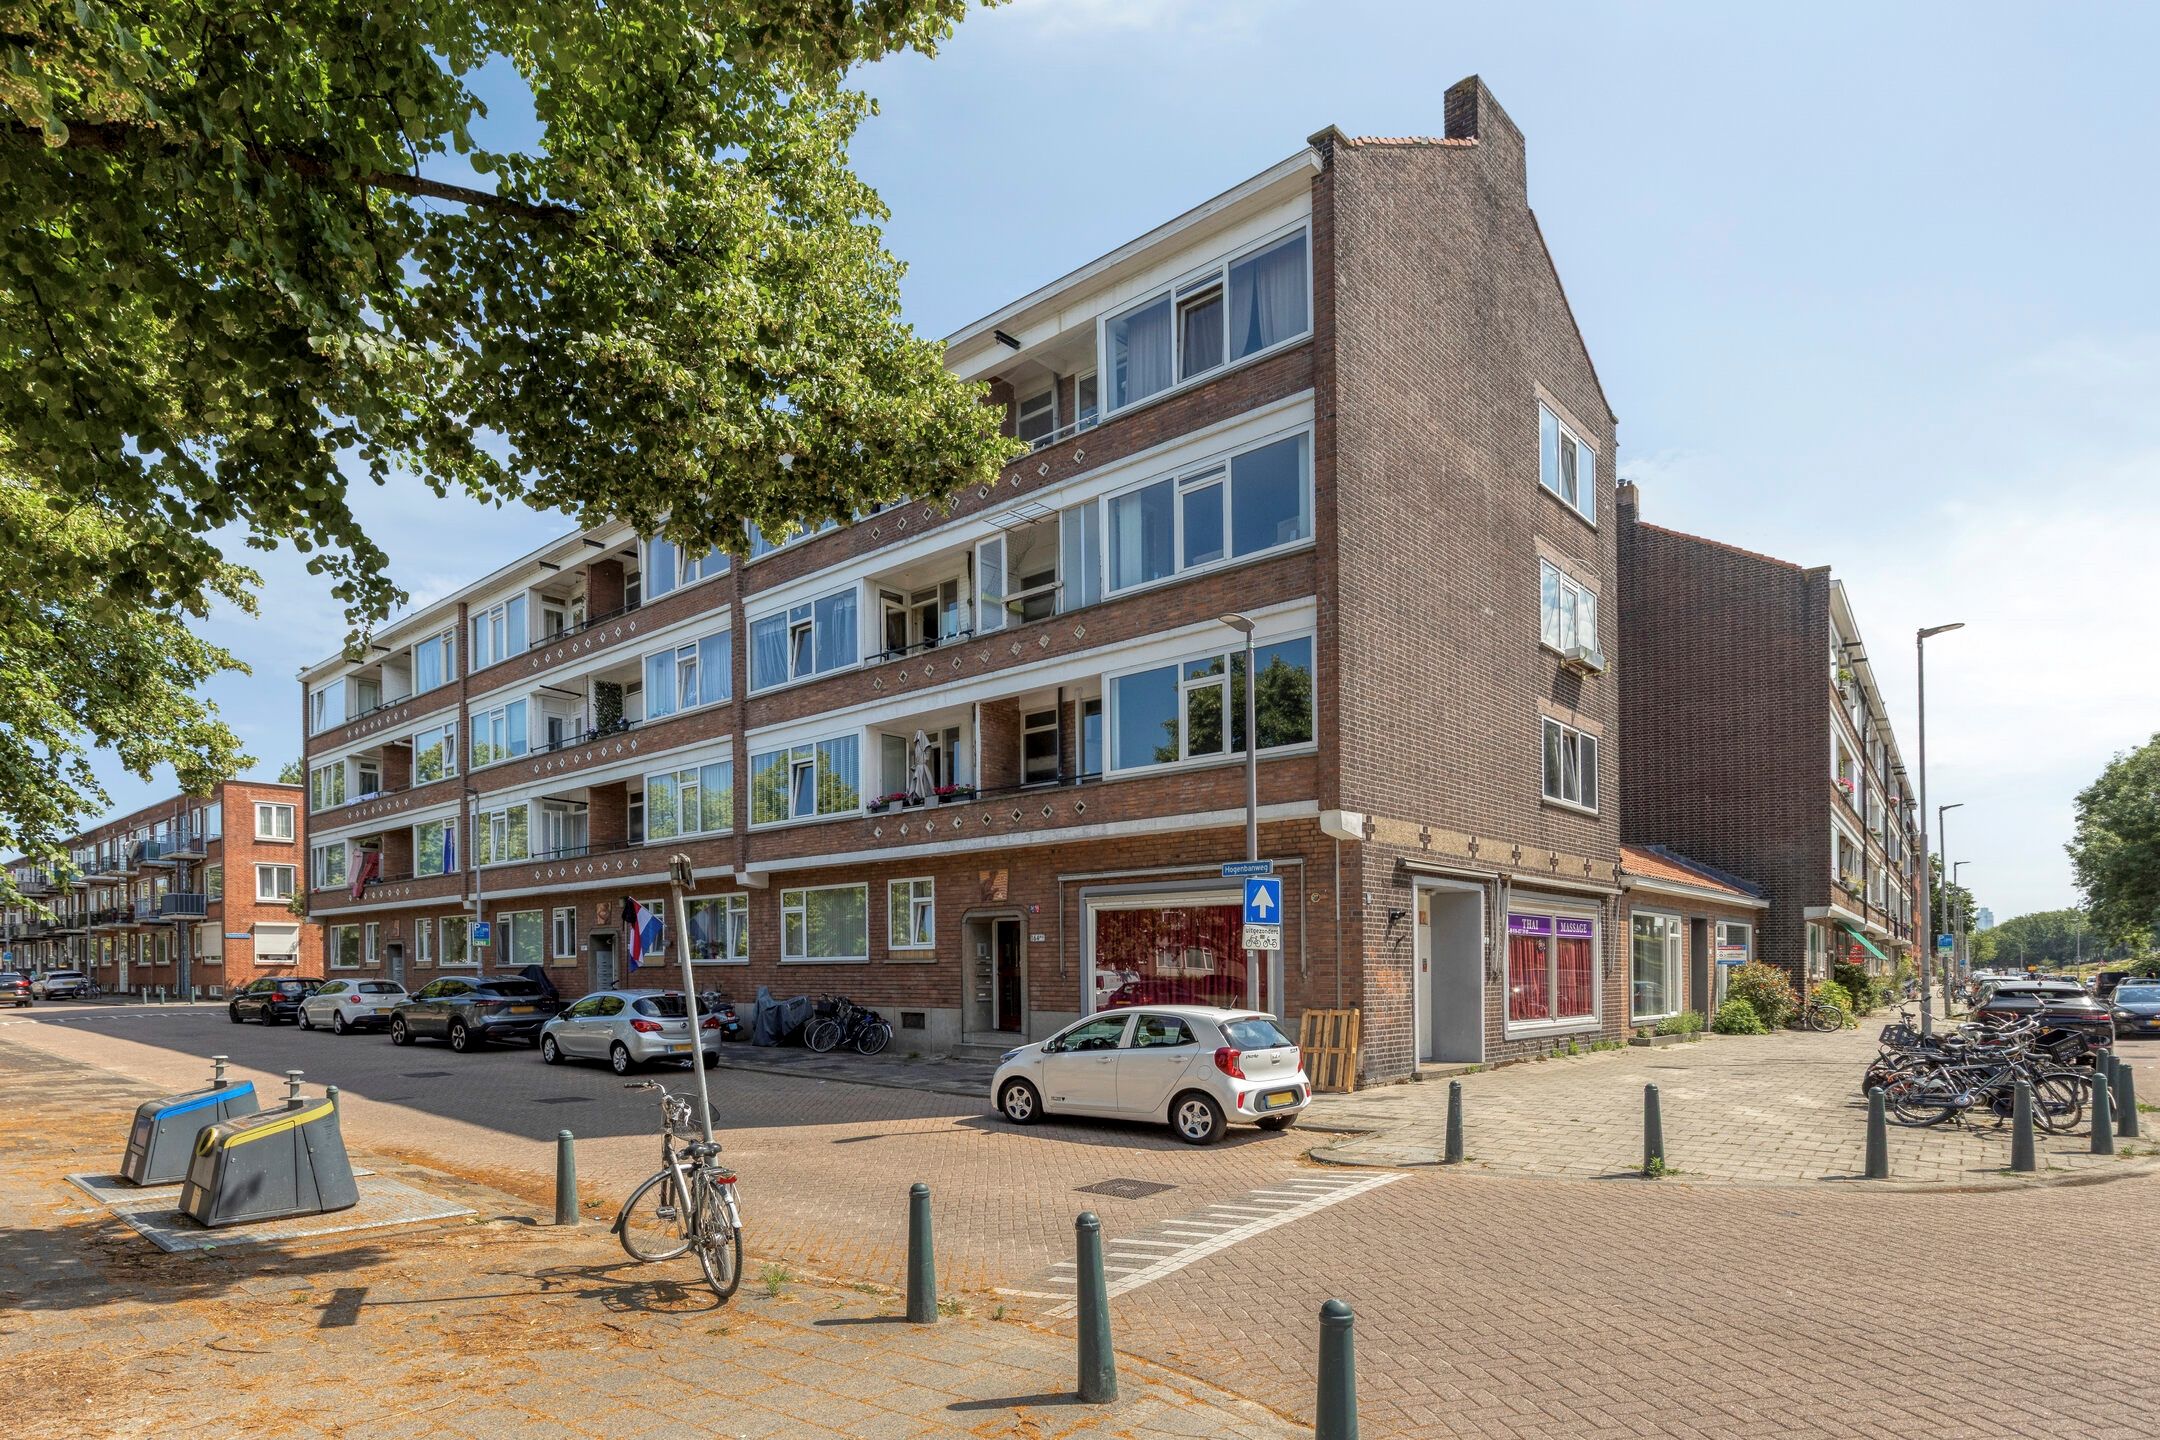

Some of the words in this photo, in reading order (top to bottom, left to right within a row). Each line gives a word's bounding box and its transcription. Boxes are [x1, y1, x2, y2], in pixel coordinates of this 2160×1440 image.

[1225, 864, 1268, 874] Hogenbanweg
[474, 923, 480, 931] P
[1522, 918, 1539, 930] THAI
[1560, 923, 1587, 933] MASSAGE
[1245, 927, 1279, 935] uitgezonderd
